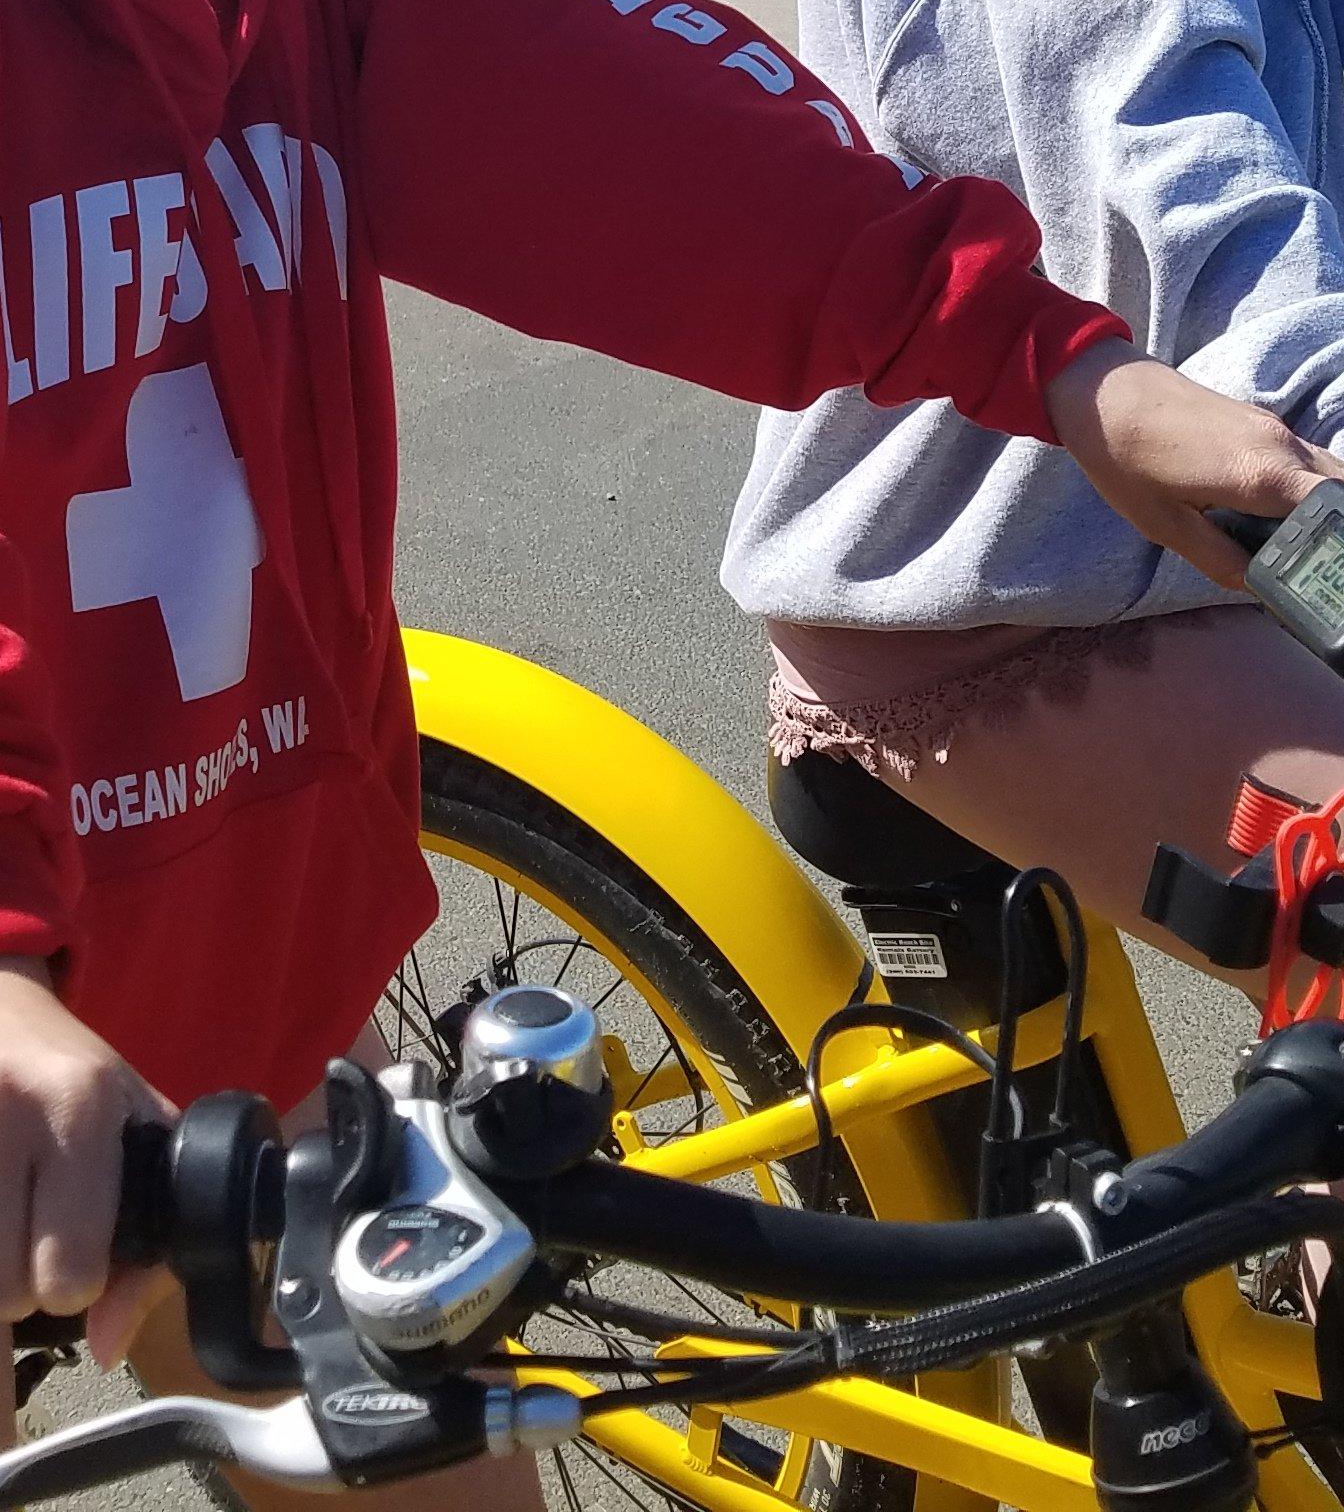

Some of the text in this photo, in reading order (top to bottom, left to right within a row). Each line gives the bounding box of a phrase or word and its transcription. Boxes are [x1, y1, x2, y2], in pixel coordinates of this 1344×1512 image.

[70, 763, 187, 836] OCEAN
[194, 718, 259, 807] SHOS,
[1140, 1412, 1209, 1455] neco
